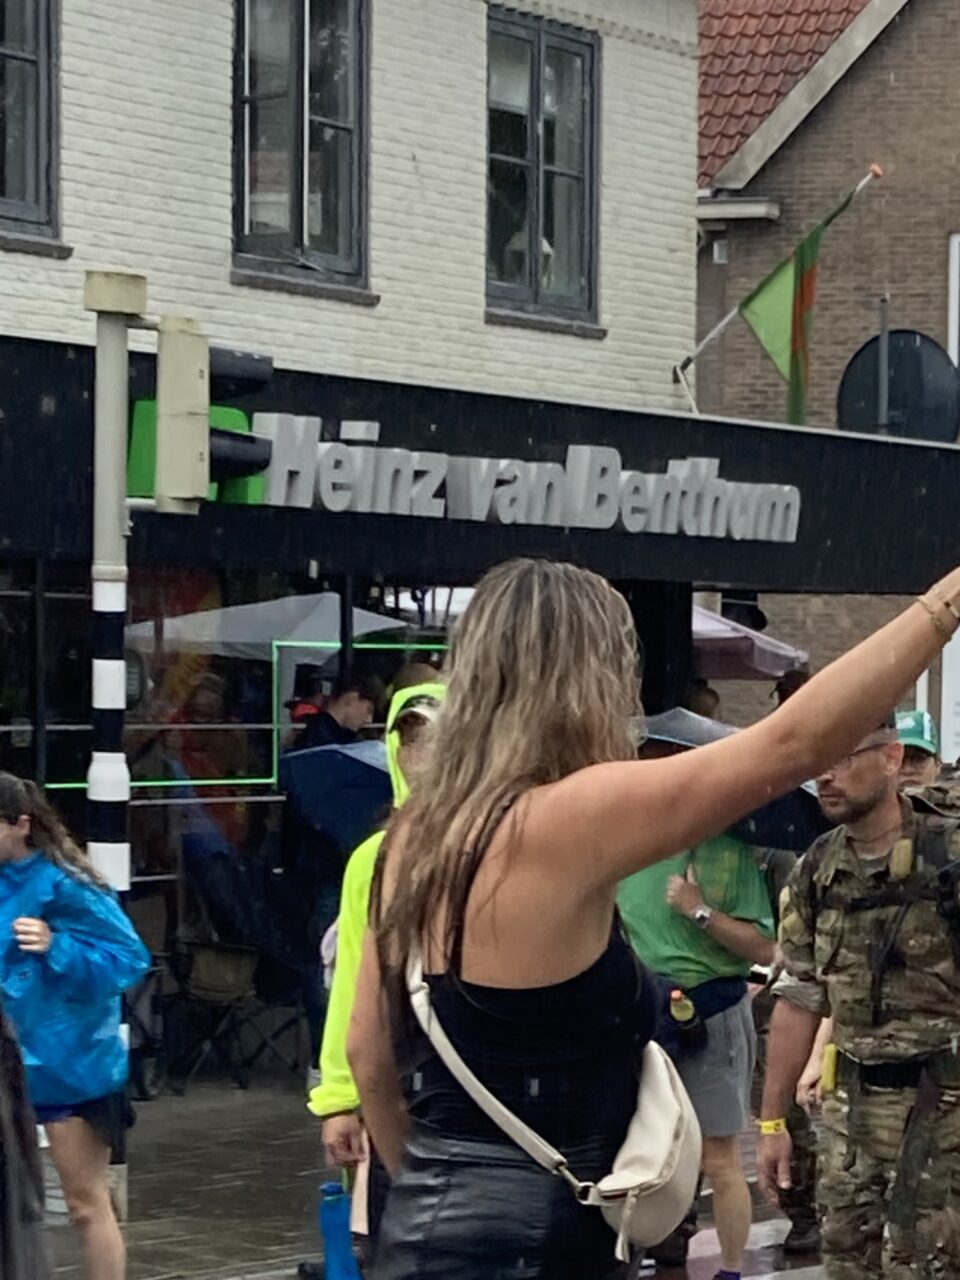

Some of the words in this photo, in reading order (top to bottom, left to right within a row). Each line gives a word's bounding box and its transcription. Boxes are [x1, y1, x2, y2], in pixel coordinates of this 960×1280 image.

[252, 412, 448, 518] Heinz
[449, 456, 566, 526] van
[566, 444, 801, 543] Benthum
